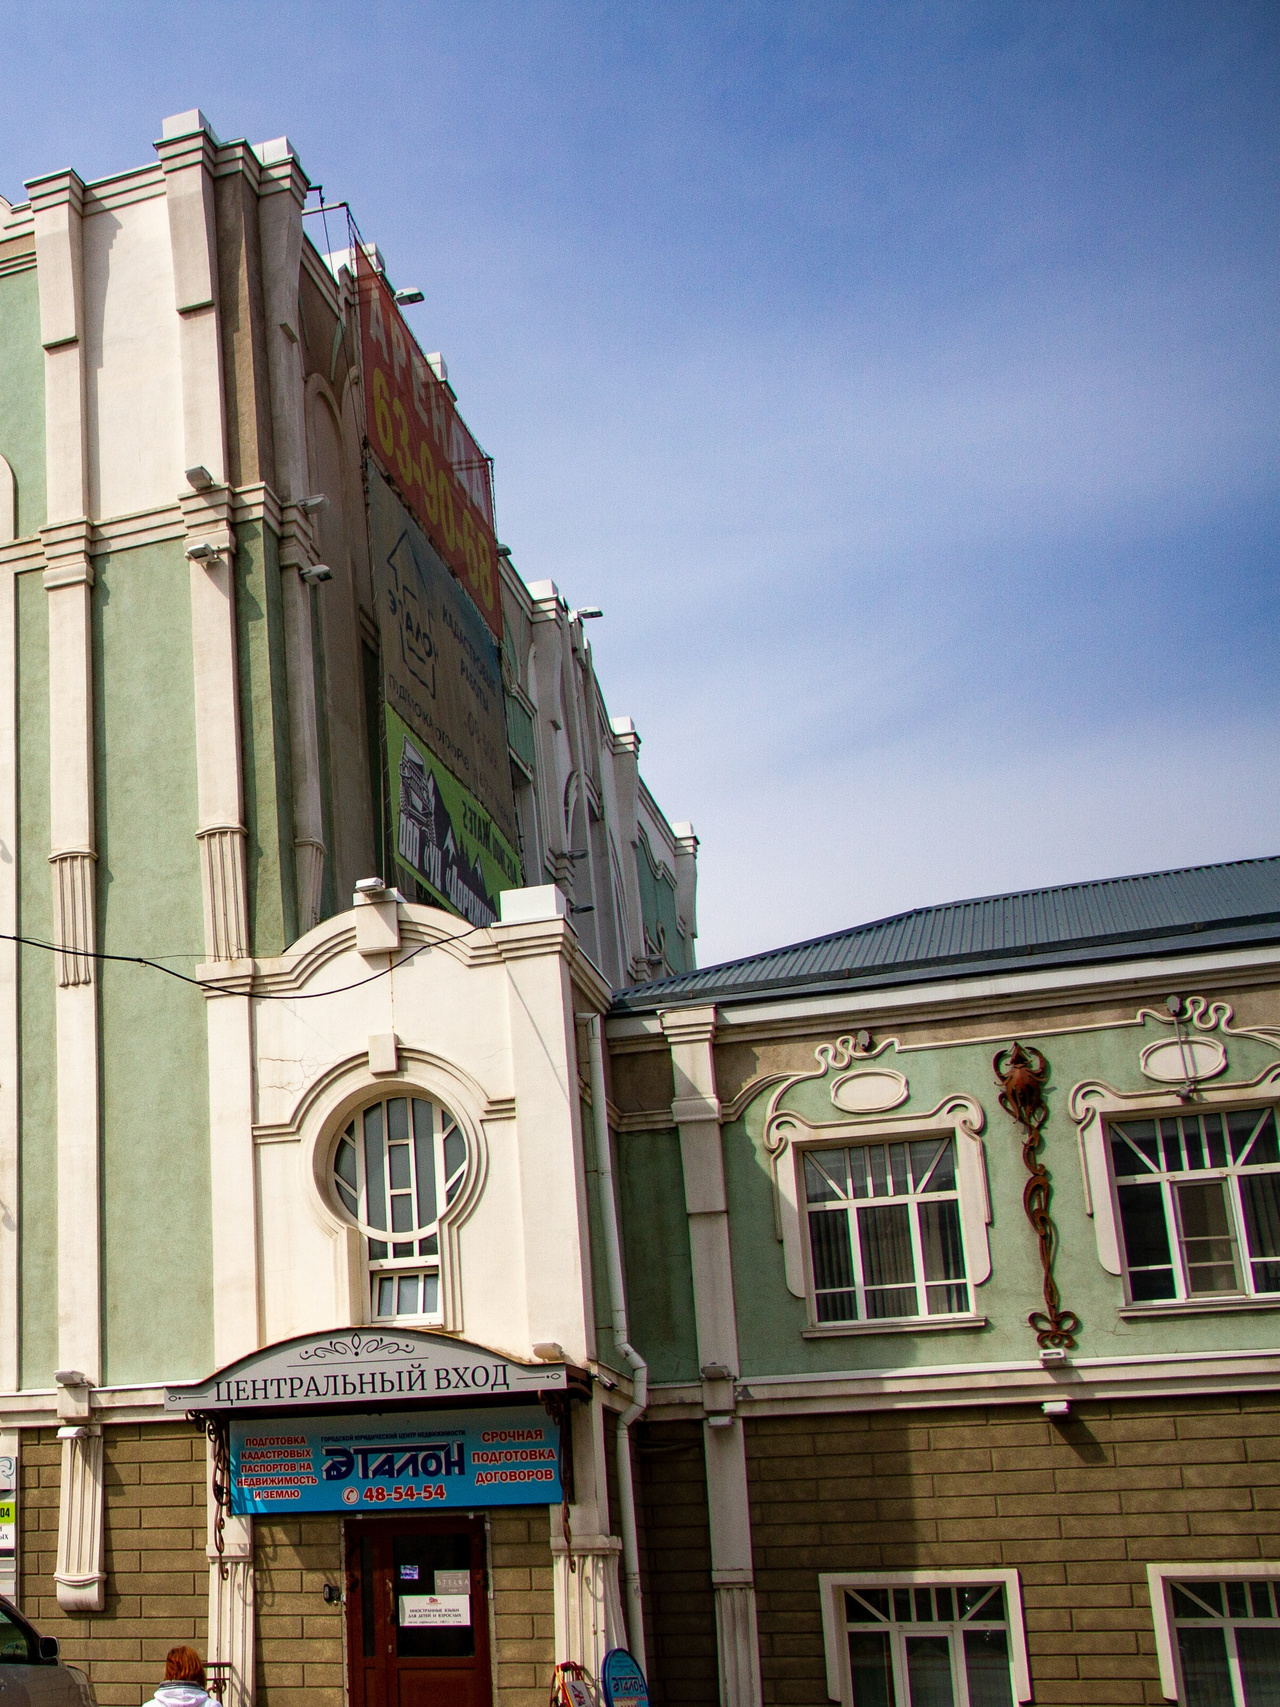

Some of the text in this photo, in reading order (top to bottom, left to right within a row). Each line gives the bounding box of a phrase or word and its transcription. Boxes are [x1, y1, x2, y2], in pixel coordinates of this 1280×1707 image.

[371, 281, 488, 530] АРЕНДА
[373, 367, 494, 612] 63-90-68
[214, 1363, 510, 1405] ЦЕНТРАЛЬНЫЙ ВХОД
[245, 1436, 307, 1448] ПОДГОТОВКА
[398, 1431, 417, 1440] ЦЕНТР
[481, 1429, 543, 1443] СРОЧНАЯ
[241, 1449, 312, 1461] КАДАСТРОВЫХ
[321, 1440, 466, 1481] ЭТАЛОН
[472, 1448, 557, 1464] ПОДГОТОВКА
[241, 1462, 313, 1474] ПАСПОРТОВ НА
[236, 1475, 318, 1488] НЕДВИЖИМОСТЬ
[475, 1469, 554, 1486] ДОГОВОРОВ
[253, 1489, 301, 1500] И ЗЕМЛЮ
[363, 1484, 446, 1502] 48-54-54
